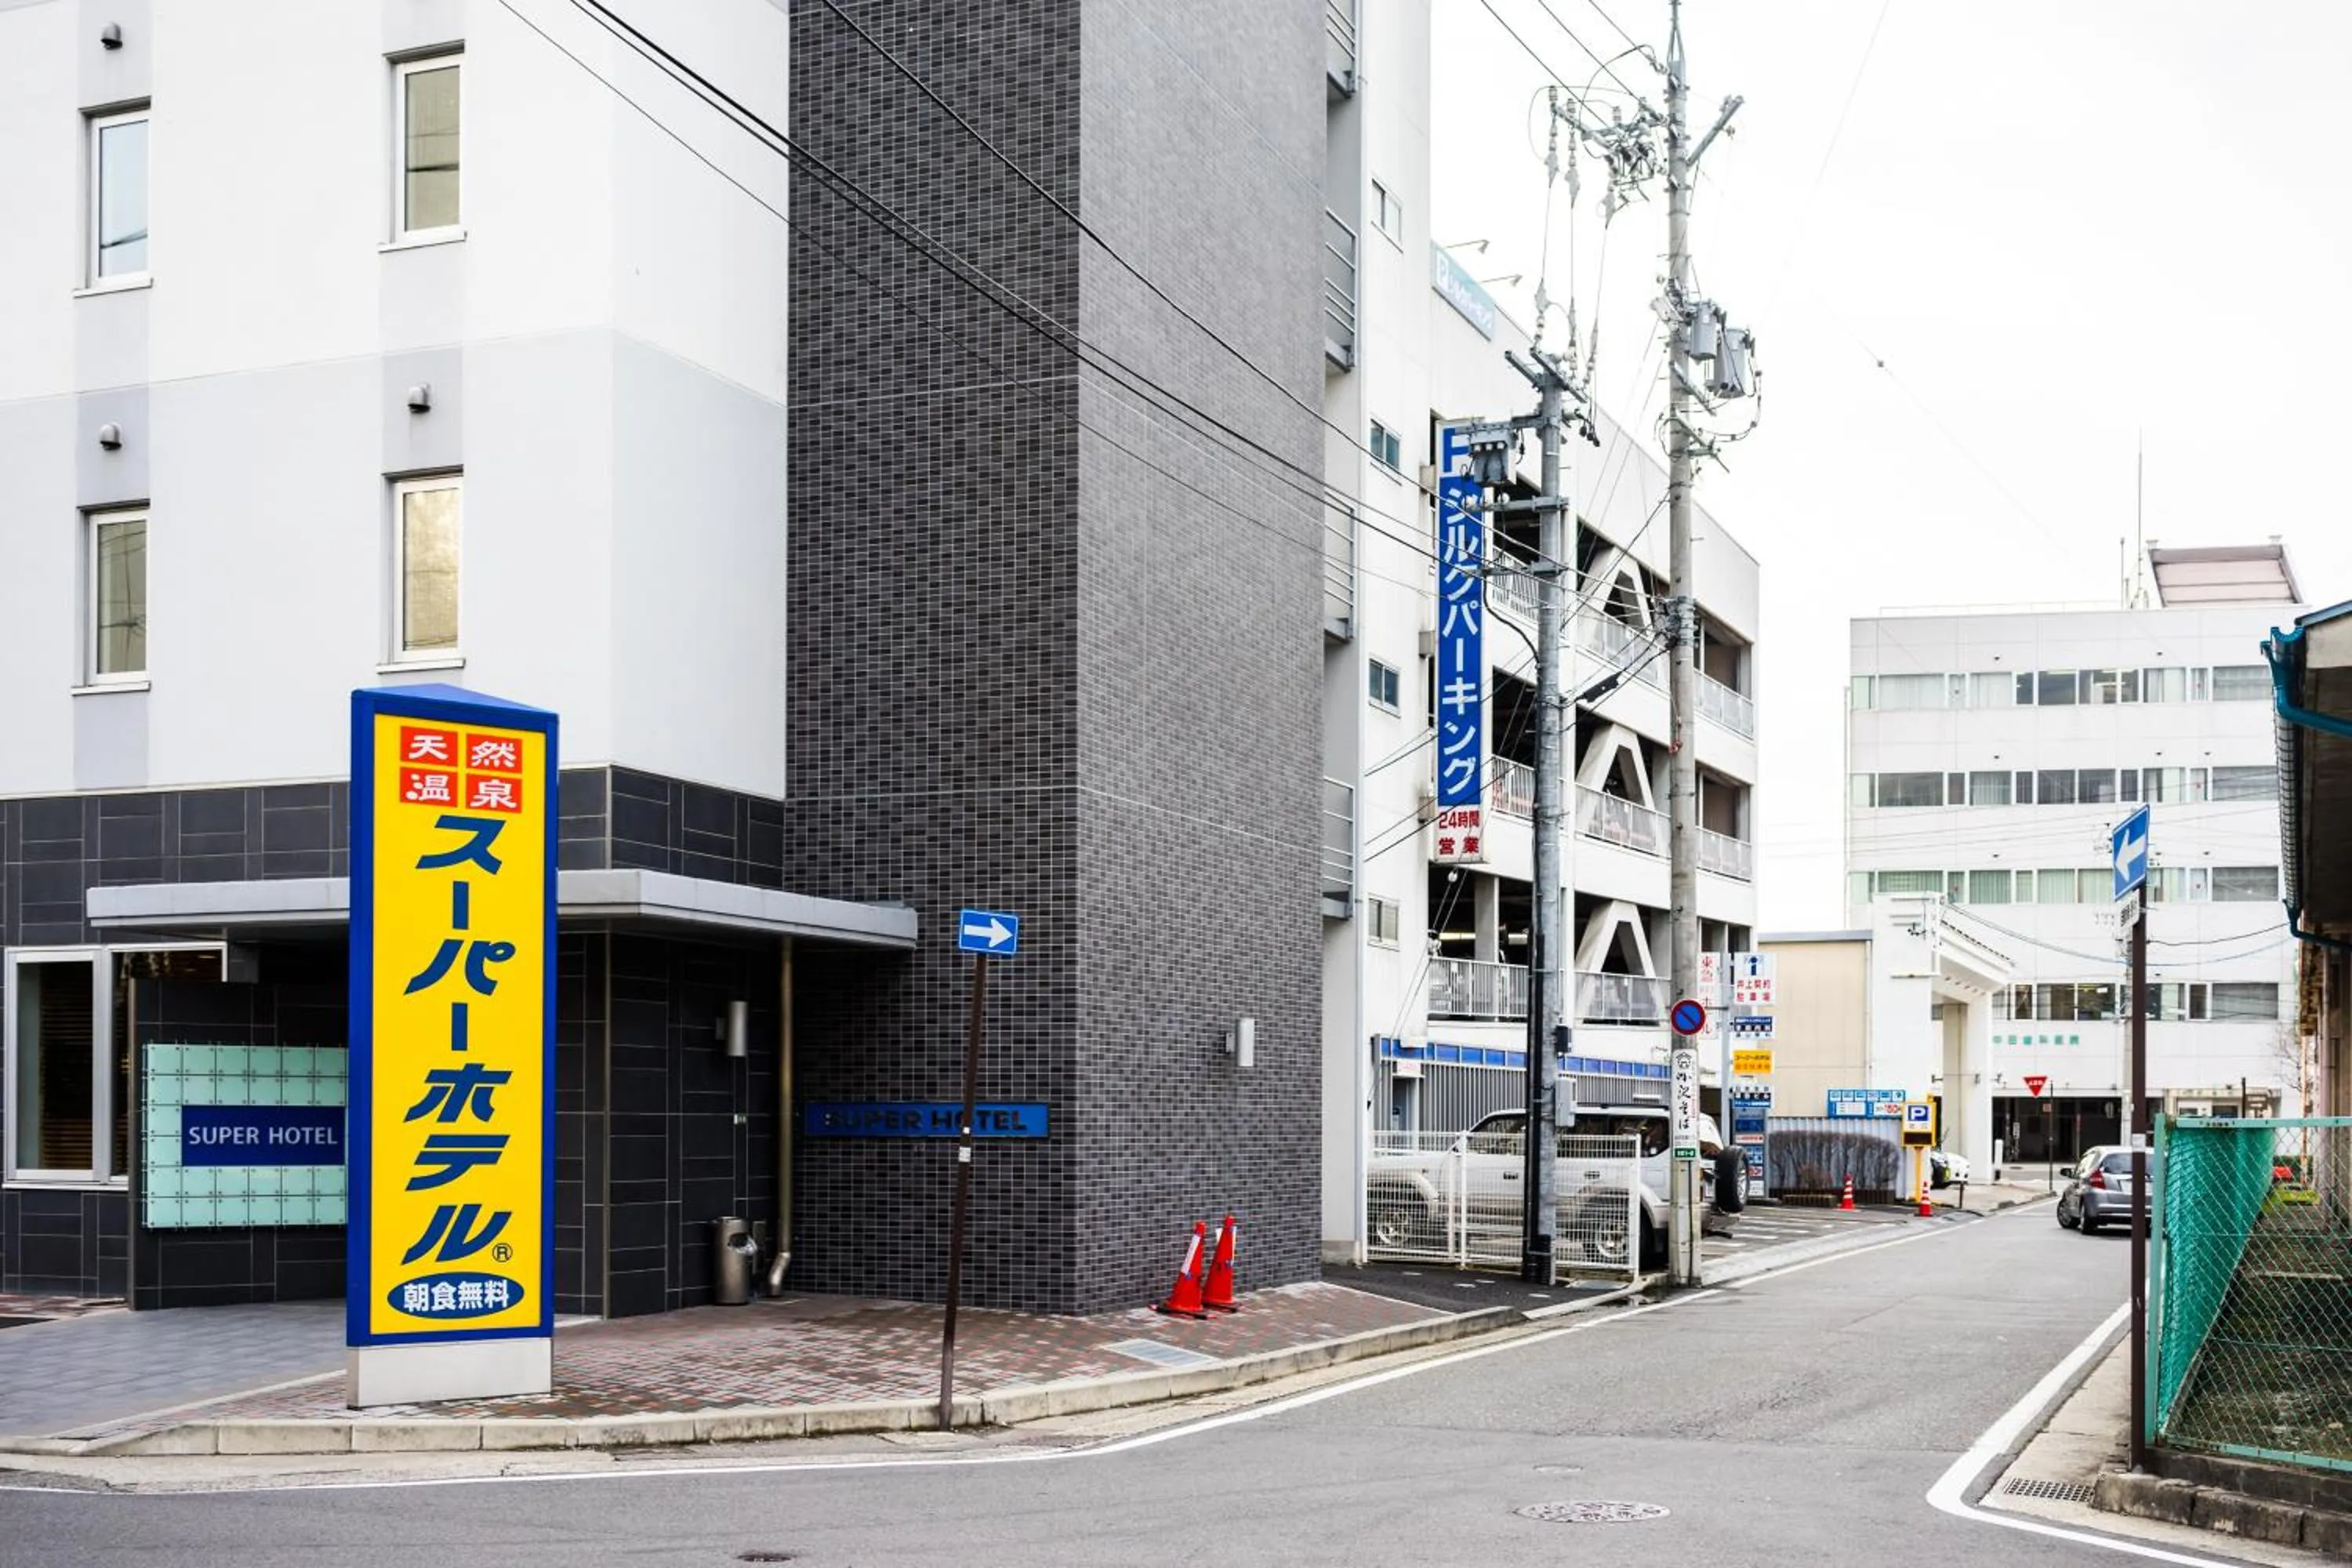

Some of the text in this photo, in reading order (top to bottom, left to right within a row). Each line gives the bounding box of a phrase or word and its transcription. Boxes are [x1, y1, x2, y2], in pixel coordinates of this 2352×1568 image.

[408, 734, 517, 768] 天然
[405, 773, 517, 808] 温泉
[1438, 810, 1480, 829] 24時間
[1438, 837, 1480, 855] 営業
[401, 815, 516, 1266] スーパーホテル
[1911, 1106, 1926, 1121] P
[188, 1126, 338, 1145] SUPER HOTEL
[404, 1279, 509, 1312] 朝食無料
